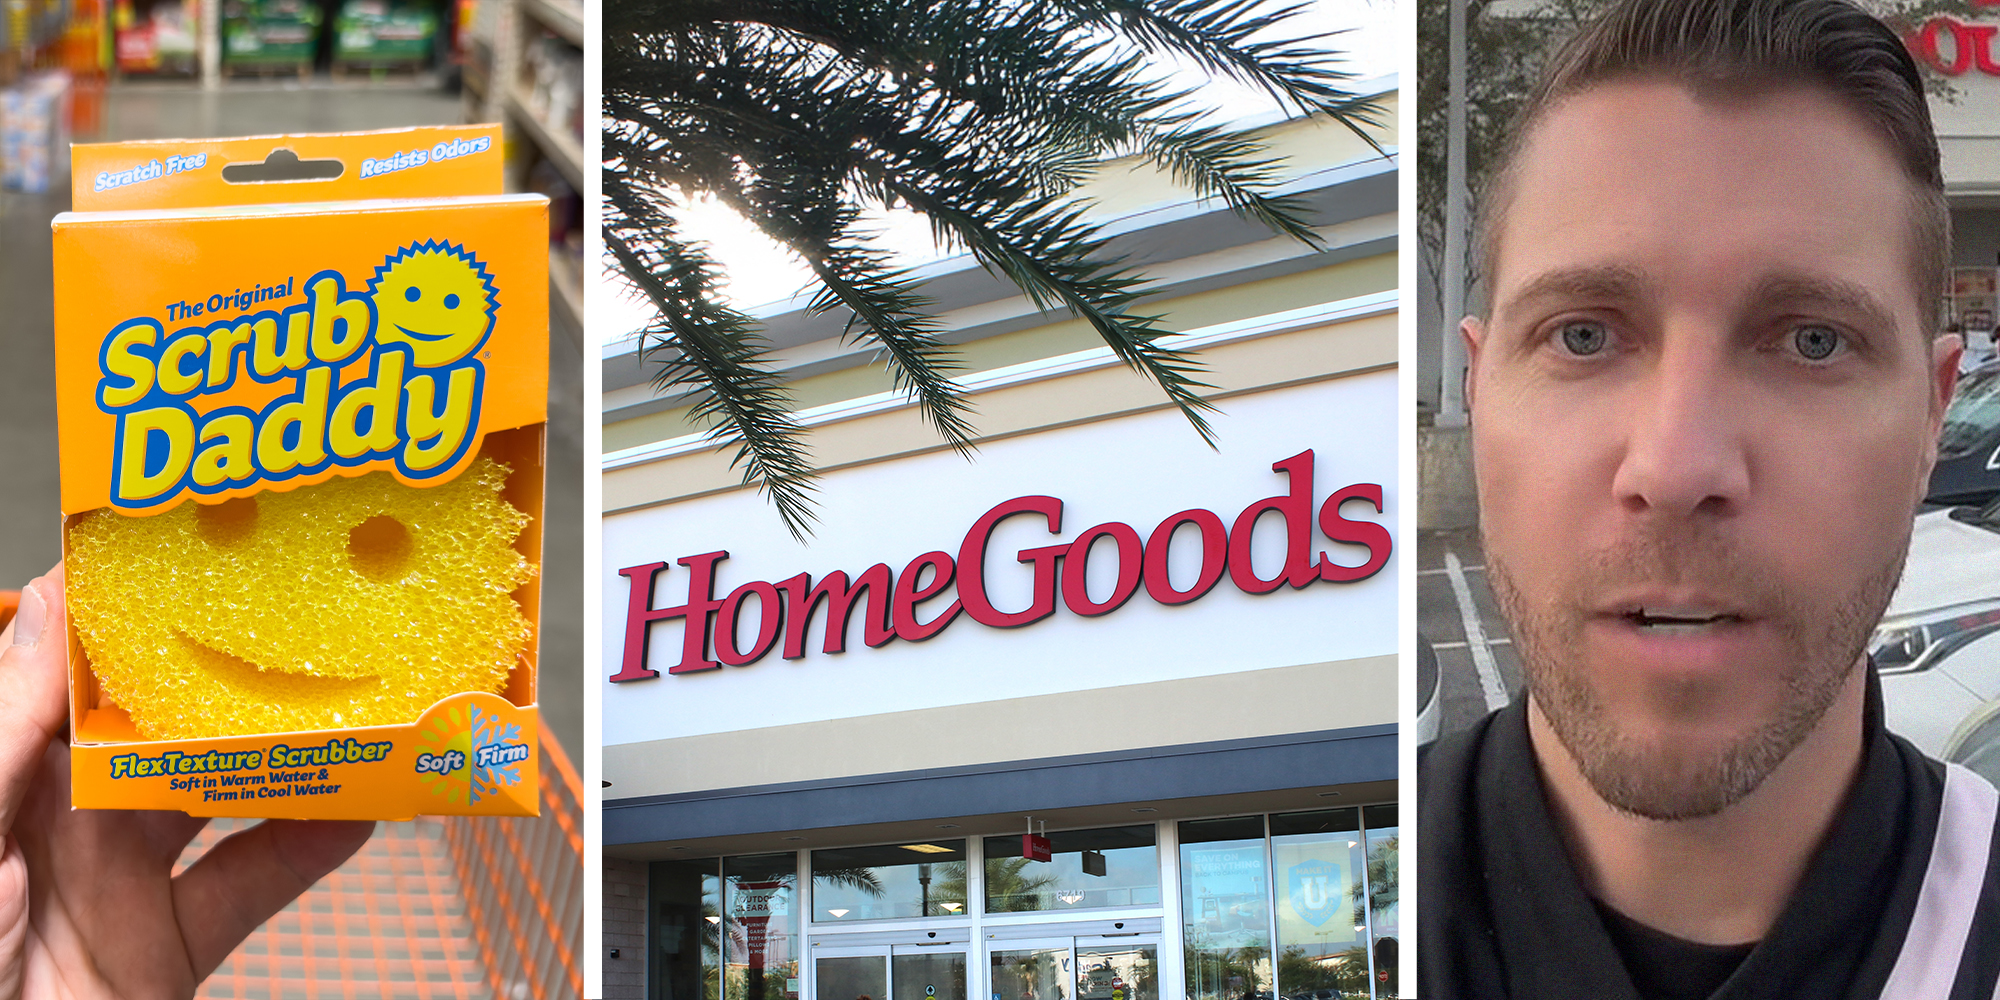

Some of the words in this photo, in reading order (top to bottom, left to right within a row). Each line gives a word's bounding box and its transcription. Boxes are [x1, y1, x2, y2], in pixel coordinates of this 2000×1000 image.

[94, 159, 162, 192] Scratch
[165, 153, 207, 176] Free
[360, 149, 429, 180] Resists
[430, 136, 491, 162] Odors
[166, 300, 203, 322] The
[207, 276, 293, 313] Original
[99, 273, 373, 411] Scrub
[114, 346, 480, 503] Daddy
[609, 448, 1392, 683] HomeGoods
[110, 750, 262, 779] FlexTexture
[268, 738, 393, 768] Scrubber
[415, 749, 466, 775] Soft
[476, 743, 529, 768] Firm
[169, 777, 200, 792] Soft
[202, 775, 217, 788] in
[220, 773, 265, 788] Warm
[269, 769, 314, 784] Water
[317, 768, 329, 780] &
[203, 788, 238, 802] Firm
[240, 786, 255, 799] in
[257, 783, 291, 798] Cool
[294, 781, 342, 796] Water
[1194, 854, 1221, 863] SAVE
[1224, 853, 1239, 861] ON
[1194, 860, 1260, 872] EVERYTHING
[1296, 866, 1322, 875] MAKE
[1324, 866, 1333, 874] IT
[735, 903, 786, 912] CLEARANCE
[1300, 875, 1329, 911] U
